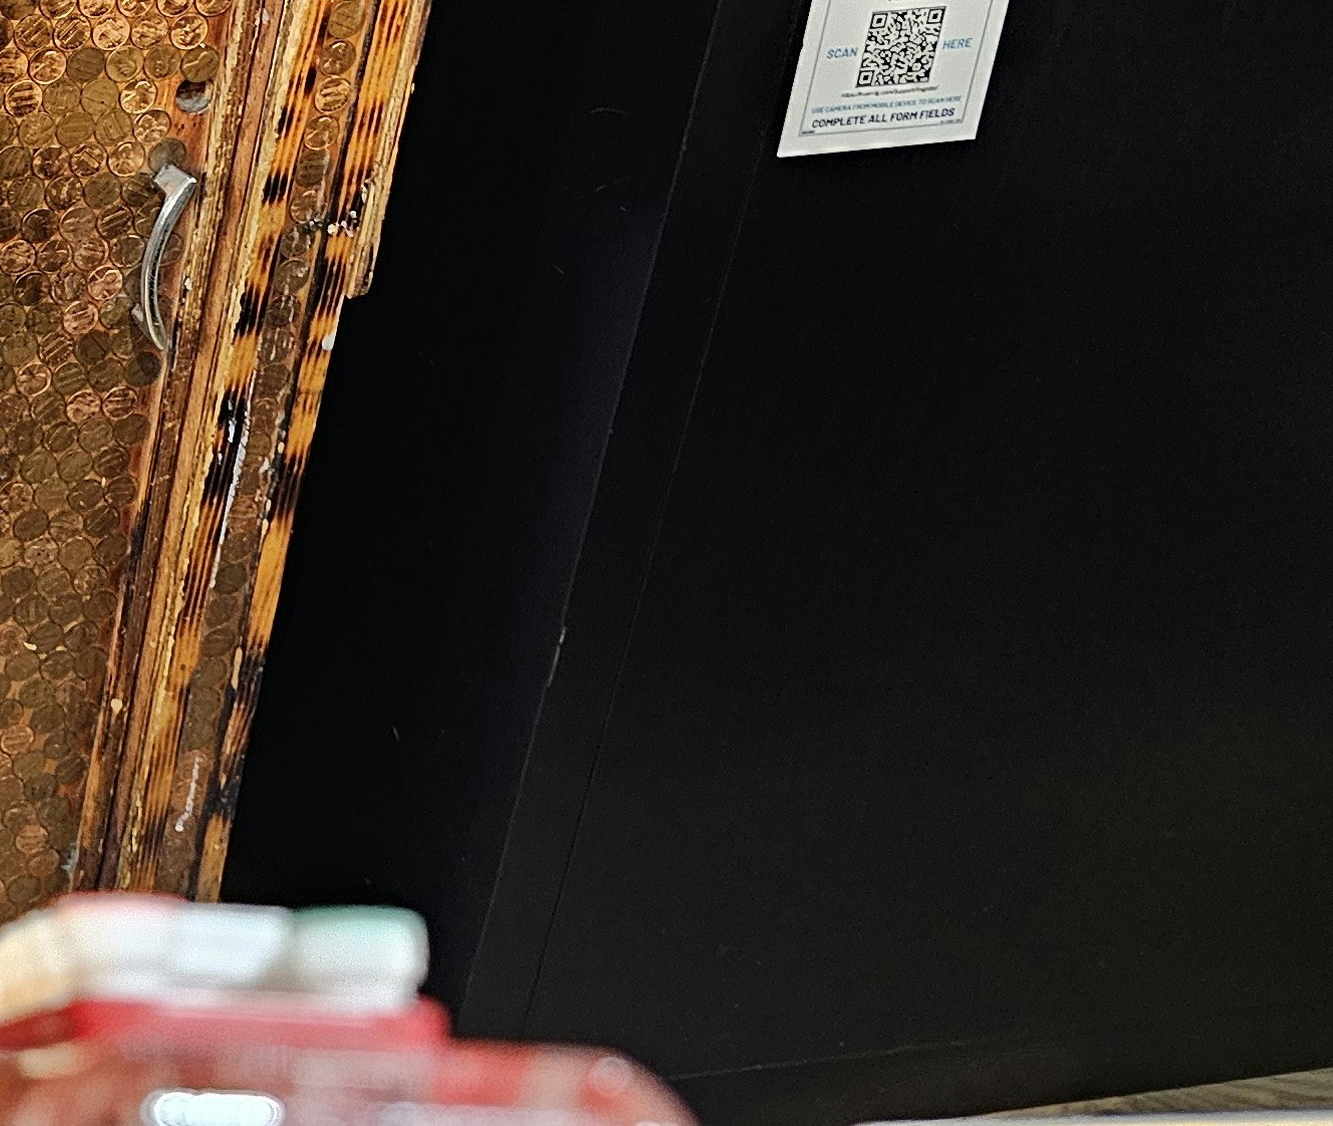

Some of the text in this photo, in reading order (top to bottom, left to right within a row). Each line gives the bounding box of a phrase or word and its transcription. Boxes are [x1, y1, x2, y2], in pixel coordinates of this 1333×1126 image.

[942, 37, 973, 50] HERE
[827, 47, 859, 60] SCAN
[811, 107, 956, 129] COMPLETE ALL FORM FIELDS
